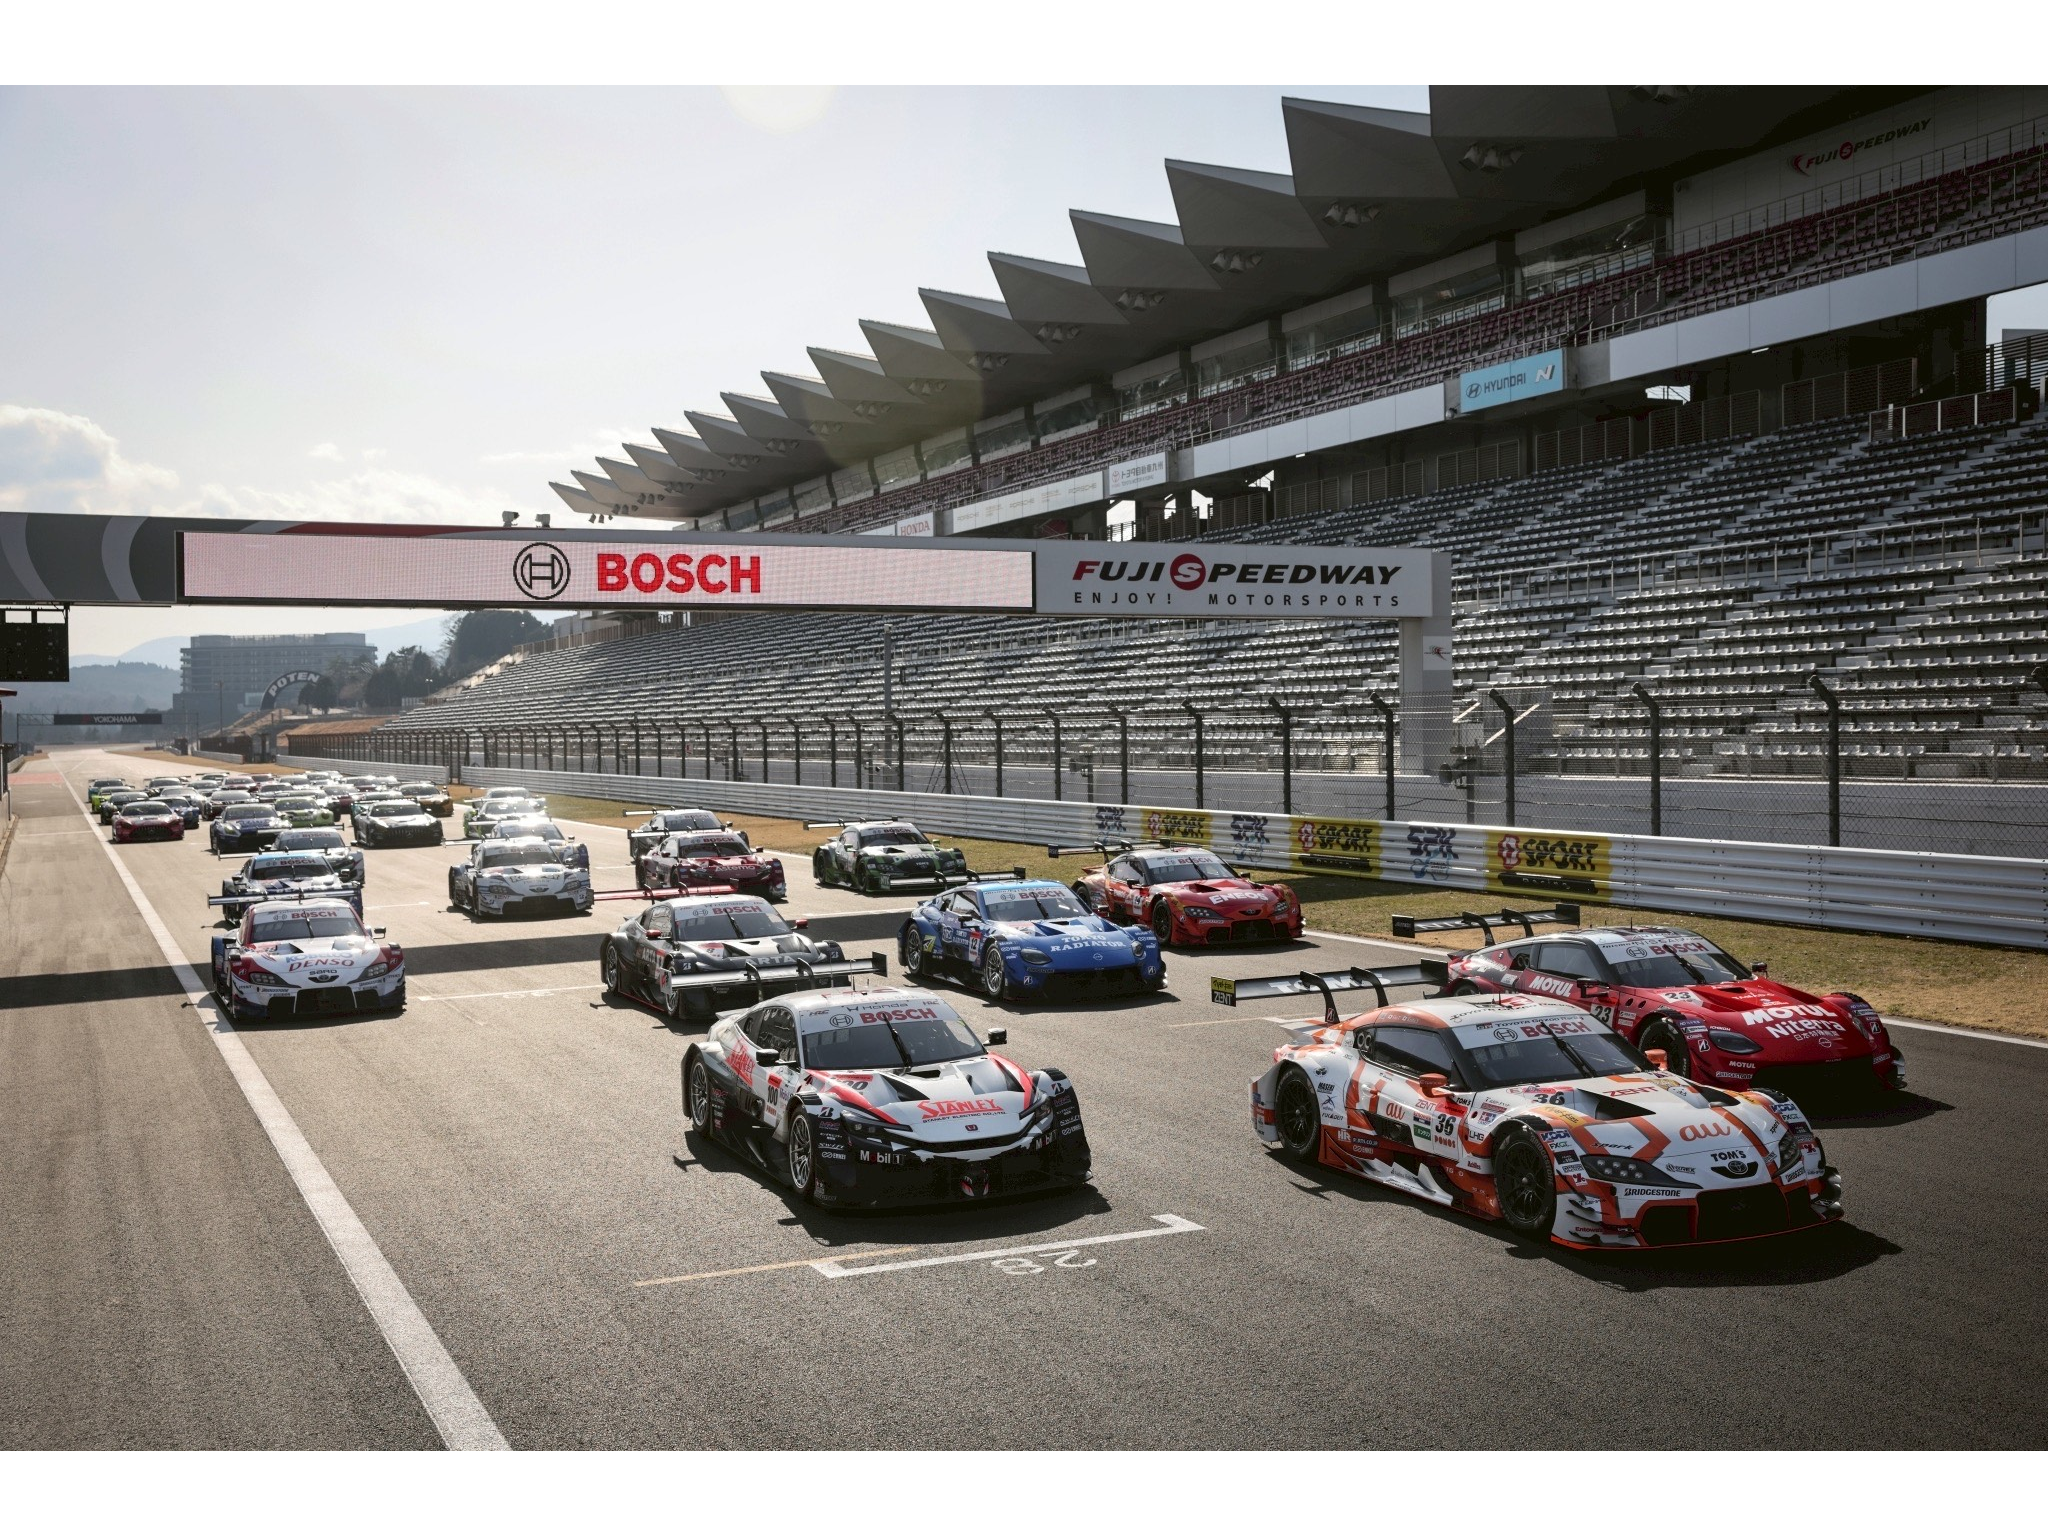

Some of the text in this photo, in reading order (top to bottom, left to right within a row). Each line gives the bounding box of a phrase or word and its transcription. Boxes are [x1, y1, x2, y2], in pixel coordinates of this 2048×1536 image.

[1806, 118, 1931, 168] FUJI SPEEDWAY
[1484, 373, 1526, 393] HYUNDAI
[1069, 483, 1097, 494] PORSCHE
[1010, 498, 1035, 508] PORSCHE
[957, 512, 979, 521] PORSCHE
[900, 521, 931, 536] HONDA
[597, 553, 761, 593] BOSCH
[1072, 555, 1402, 590] FUJI SPEEDWAY
[1074, 592, 1400, 606] ENJOY! MOTORSPORTS
[93, 716, 137, 724] YOKOHAMA
[1407, 826, 1459, 859] SPK
[1523, 838, 1598, 871] SPORT
[715, 865, 755, 873] Astemo
[1019, 890, 1065, 899] BOSCH
[1209, 892, 1269, 905] ENEOS
[291, 911, 337, 919] BOSCH
[713, 905, 762, 915] BOSCH
[971, 939, 977, 950] 12
[1061, 934, 1107, 943] TOKYO
[1050, 940, 1126, 952] RADIATOR
[1649, 942, 1708, 955] BOSCH
[289, 958, 355, 972] DENSO
[743, 955, 795, 966] ARTA
[1529, 976, 1574, 997] MOTUL
[1214, 992, 1233, 1006] ZENT
[1665, 992, 1691, 1001] 23
[860, 1009, 937, 1024] BOSCH
[1595, 1005, 1612, 1022] 23
[1741, 1005, 1838, 1026] MOTUL
[1520, 1022, 1592, 1037] BOSCH
[1765, 1019, 1846, 1039] Niterra
[1729, 1061, 1756, 1069] MOTUL
[767, 1085, 779, 1106] 100
[1532, 1091, 1565, 1106] 36
[1602, 1087, 1659, 1097] ZENT
[917, 1099, 1004, 1119] STANLEY
[1385, 1102, 1405, 1119] au
[1415, 1099, 1436, 1111] ZENT
[1772, 1103, 1797, 1113] KDDI
[1435, 1114, 1456, 1136] 36
[1469, 1130, 1484, 1141] LHG
[1540, 1130, 1570, 1141] KDDI
[1679, 1123, 1731, 1142] au
[1434, 1135, 1456, 1148] PONOS
[860, 1150, 890, 1164] Mobil
[1711, 1150, 1748, 1162] TOM'S
[1624, 1188, 1681, 1197] BRIDGESTONE
